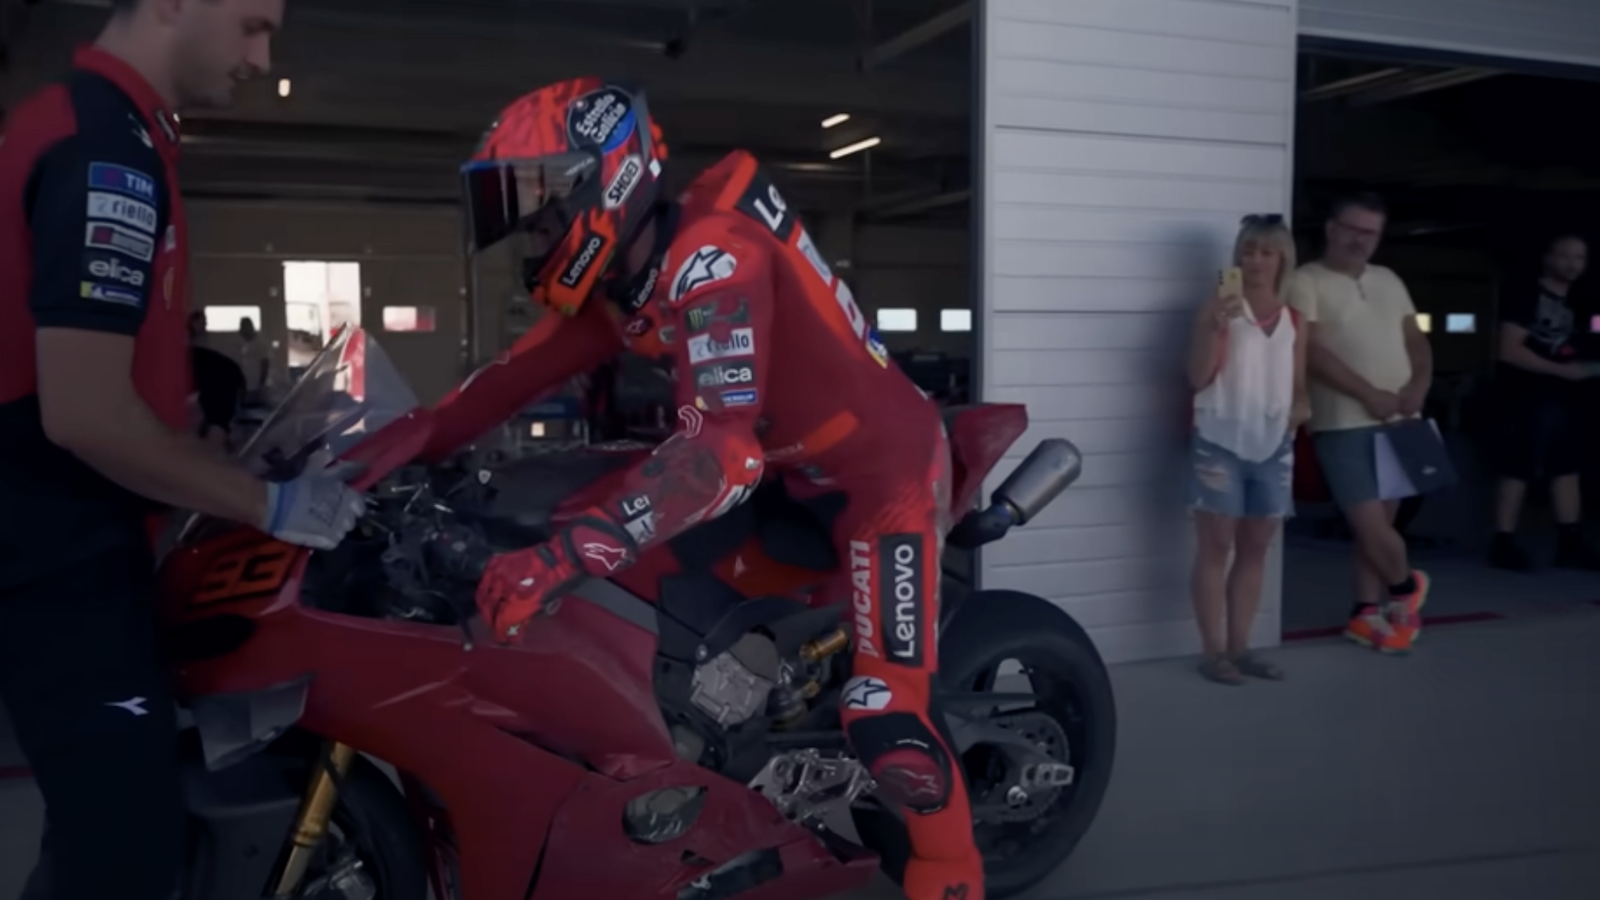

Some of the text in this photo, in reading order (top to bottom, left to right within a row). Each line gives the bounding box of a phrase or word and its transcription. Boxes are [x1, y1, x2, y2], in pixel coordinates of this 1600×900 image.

[124, 173, 154, 197] TIM
[608, 160, 639, 204] SHOEI
[112, 199, 155, 226] riello
[88, 257, 145, 288] elica
[562, 236, 601, 285] Lenovo
[698, 365, 753, 387] elica
[893, 543, 916, 658] Lenovo
